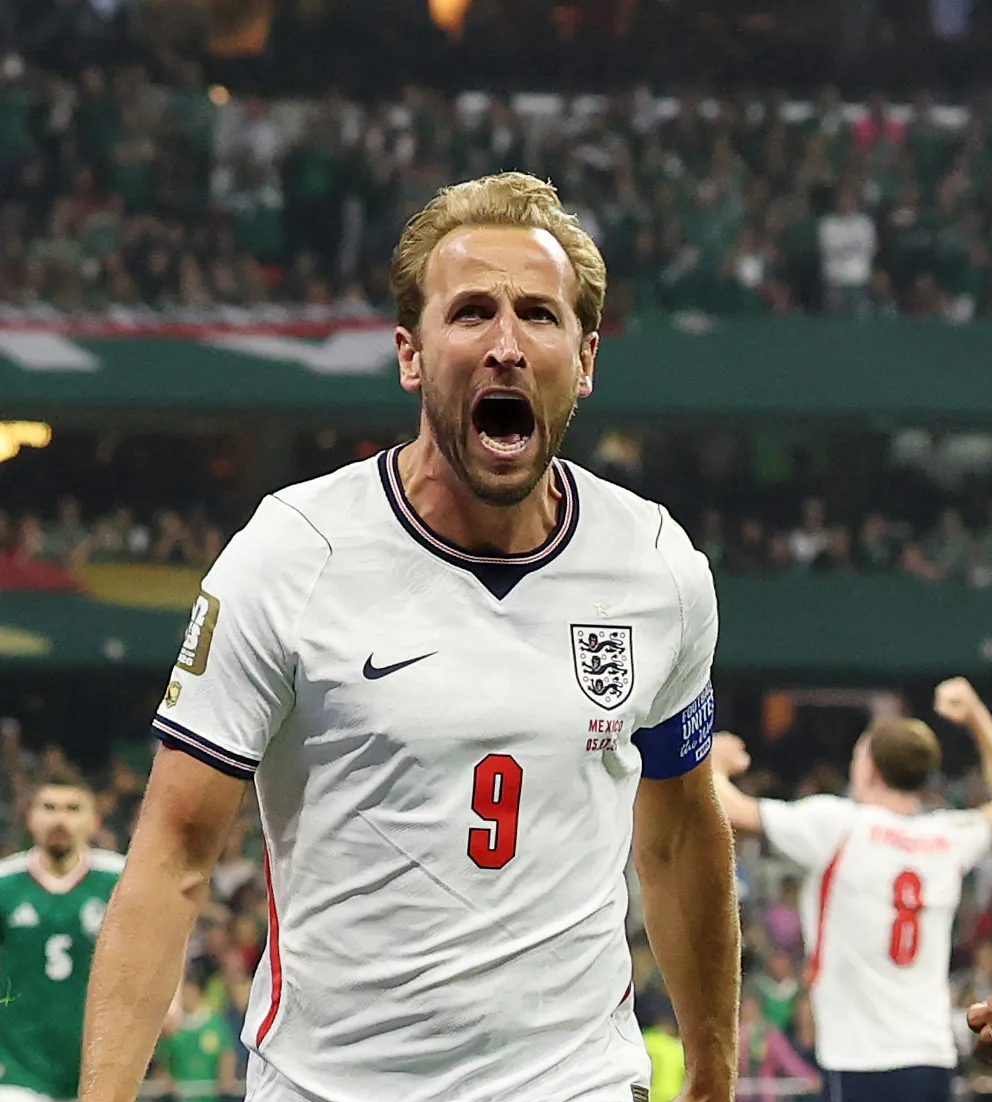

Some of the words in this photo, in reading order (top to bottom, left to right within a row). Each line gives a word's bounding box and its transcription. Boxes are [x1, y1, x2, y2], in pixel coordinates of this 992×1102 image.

[588, 719, 624, 733] MEXICO
[466, 753, 523, 869] 9
[890, 870, 922, 967] 8
[44, 933, 73, 981] 5
